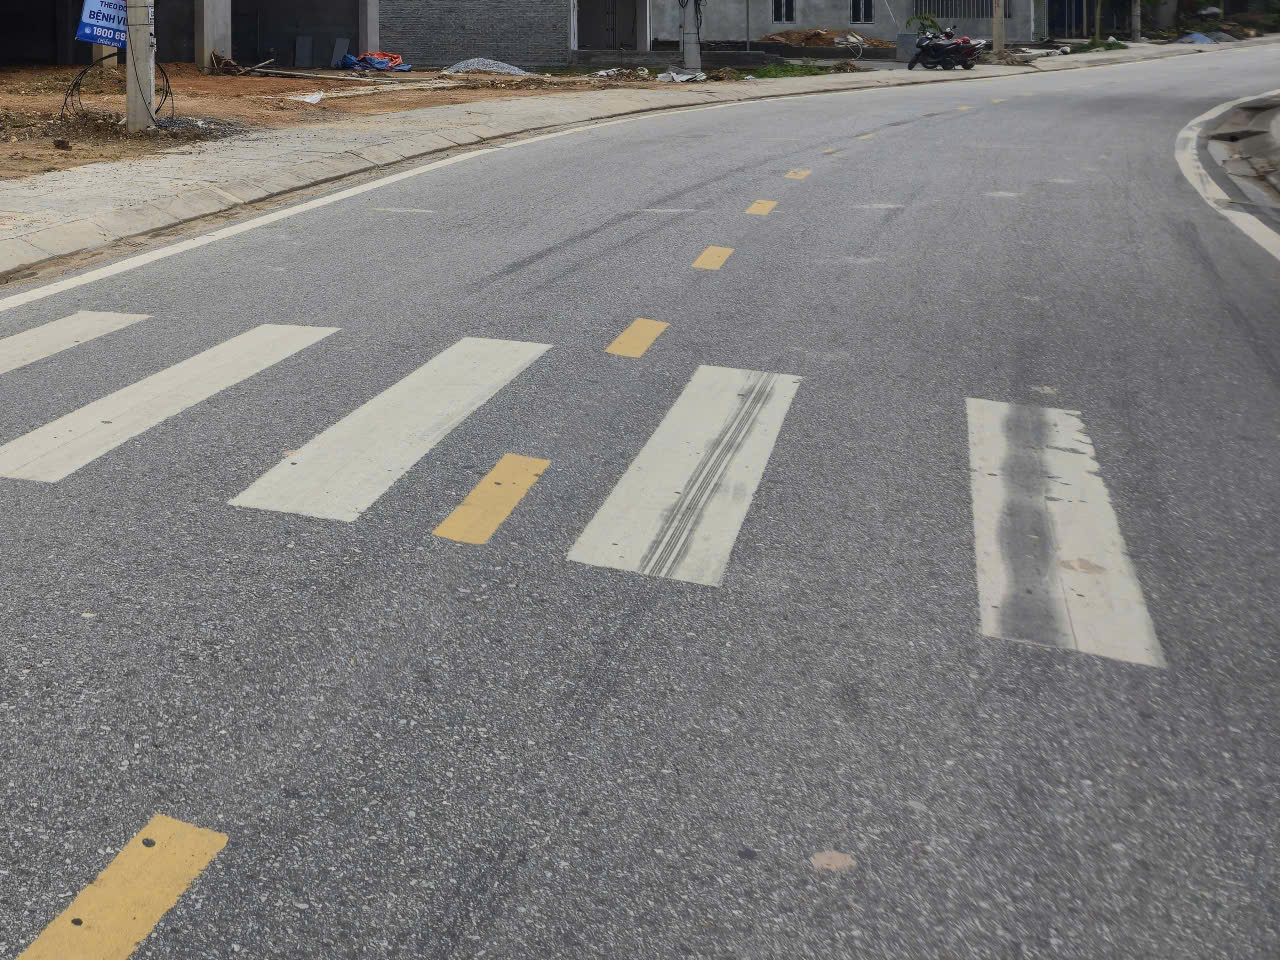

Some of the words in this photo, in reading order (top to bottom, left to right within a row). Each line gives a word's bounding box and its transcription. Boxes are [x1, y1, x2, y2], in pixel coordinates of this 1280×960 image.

[100, 0, 117, 10] THEO
[88, 9, 116, 24] BỆNH
[93, 26, 114, 39] 1800
